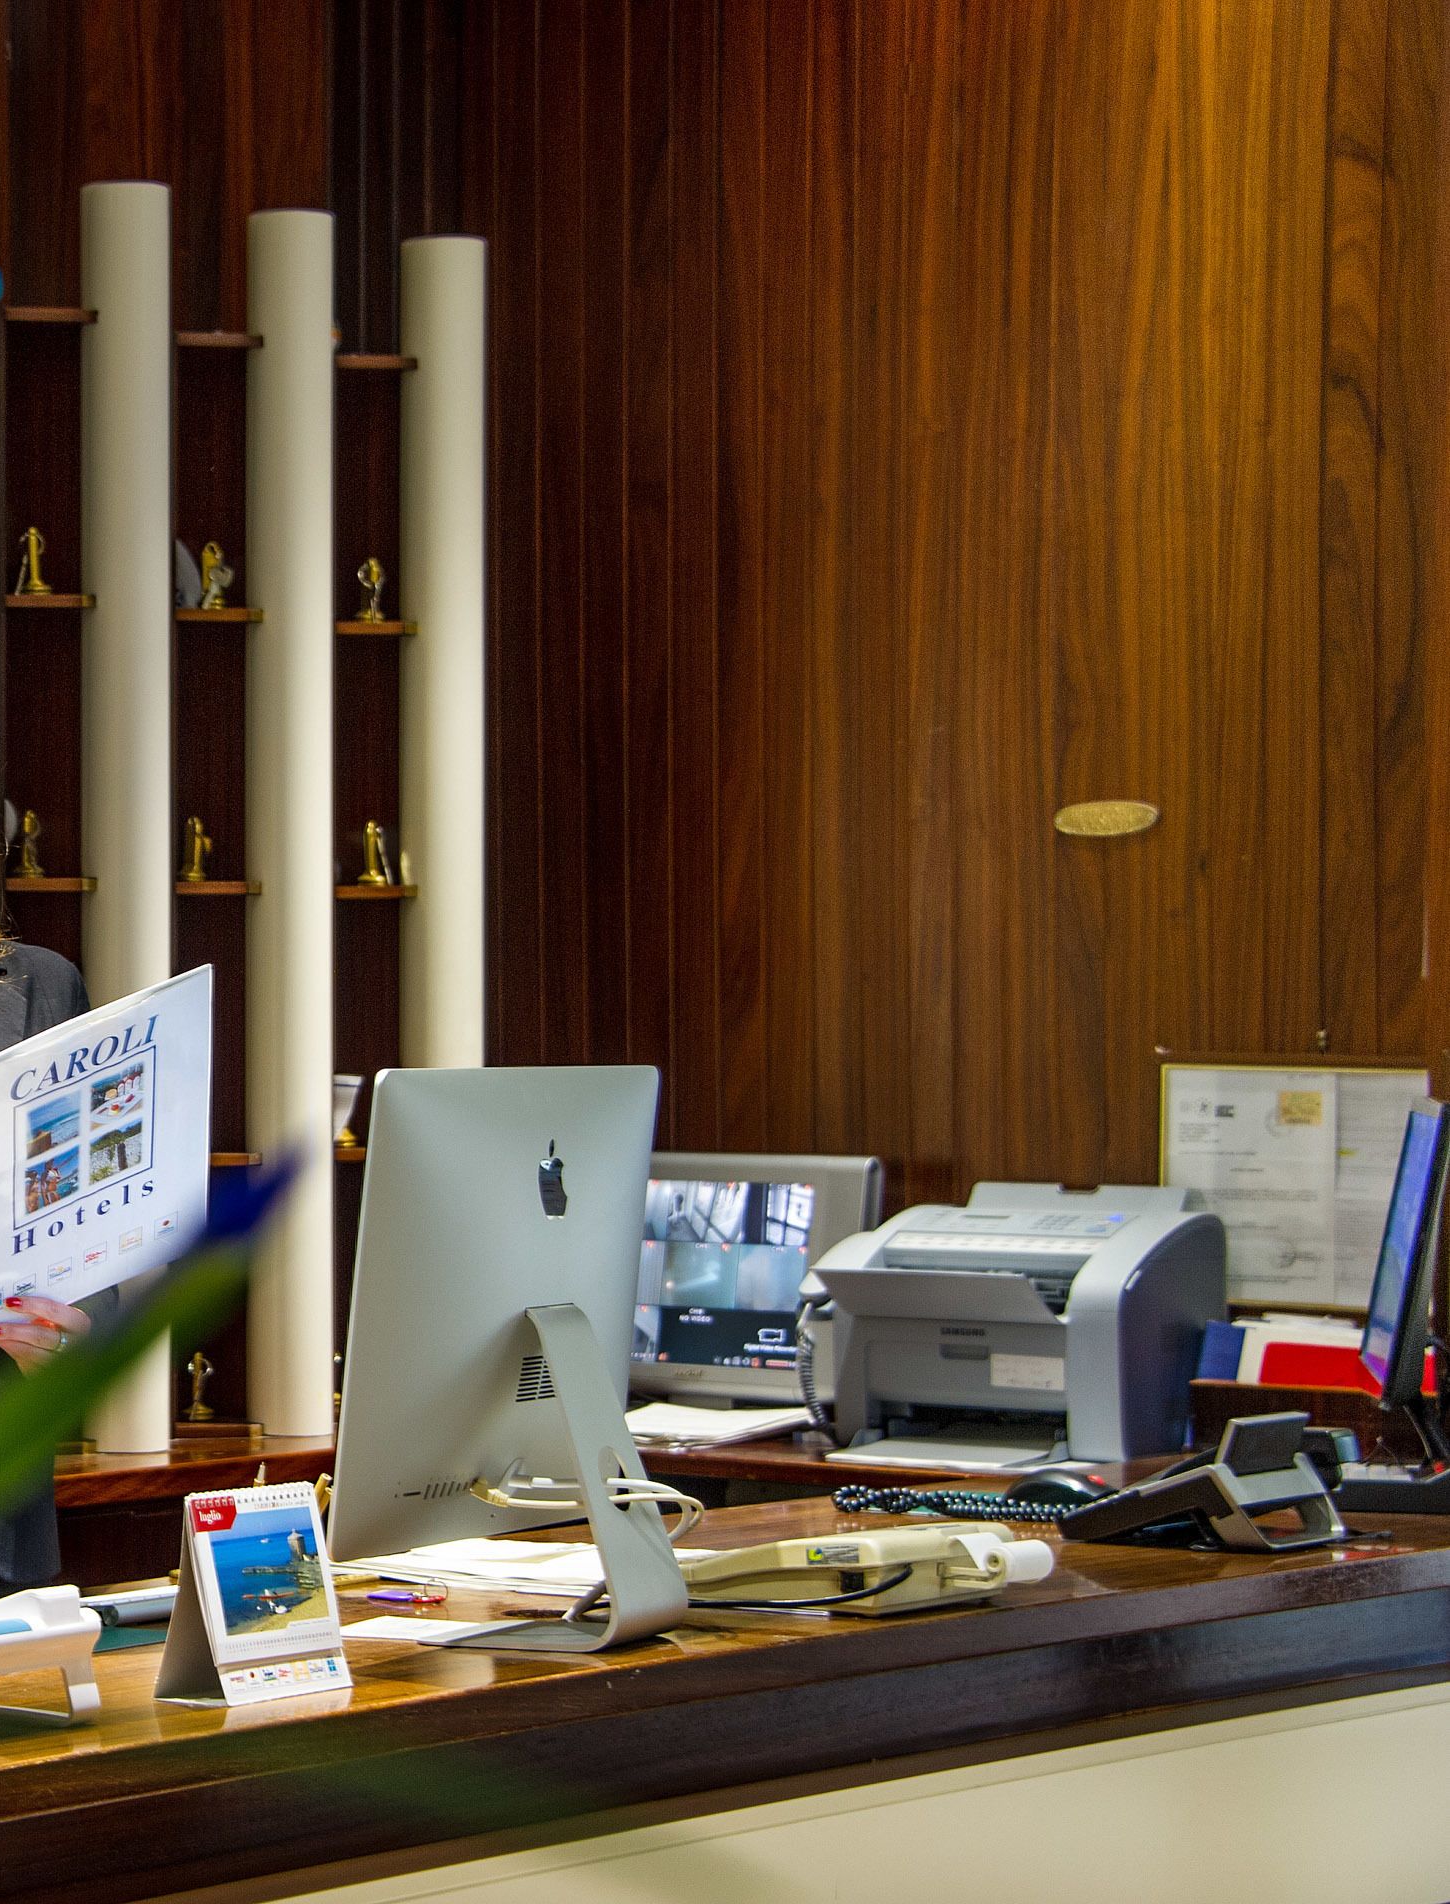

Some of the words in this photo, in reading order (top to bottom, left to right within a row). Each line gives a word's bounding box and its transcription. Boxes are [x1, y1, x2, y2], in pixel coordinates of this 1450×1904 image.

[10, 1013, 159, 1102] CAROLI
[11, 1179, 155, 1256] Hotels
[678, 1314, 689, 1322] NO
[691, 1315, 712, 1323] VIDEO
[940, 1326, 986, 1337] SAMSUNG
[199, 1509, 223, 1526] luglio
